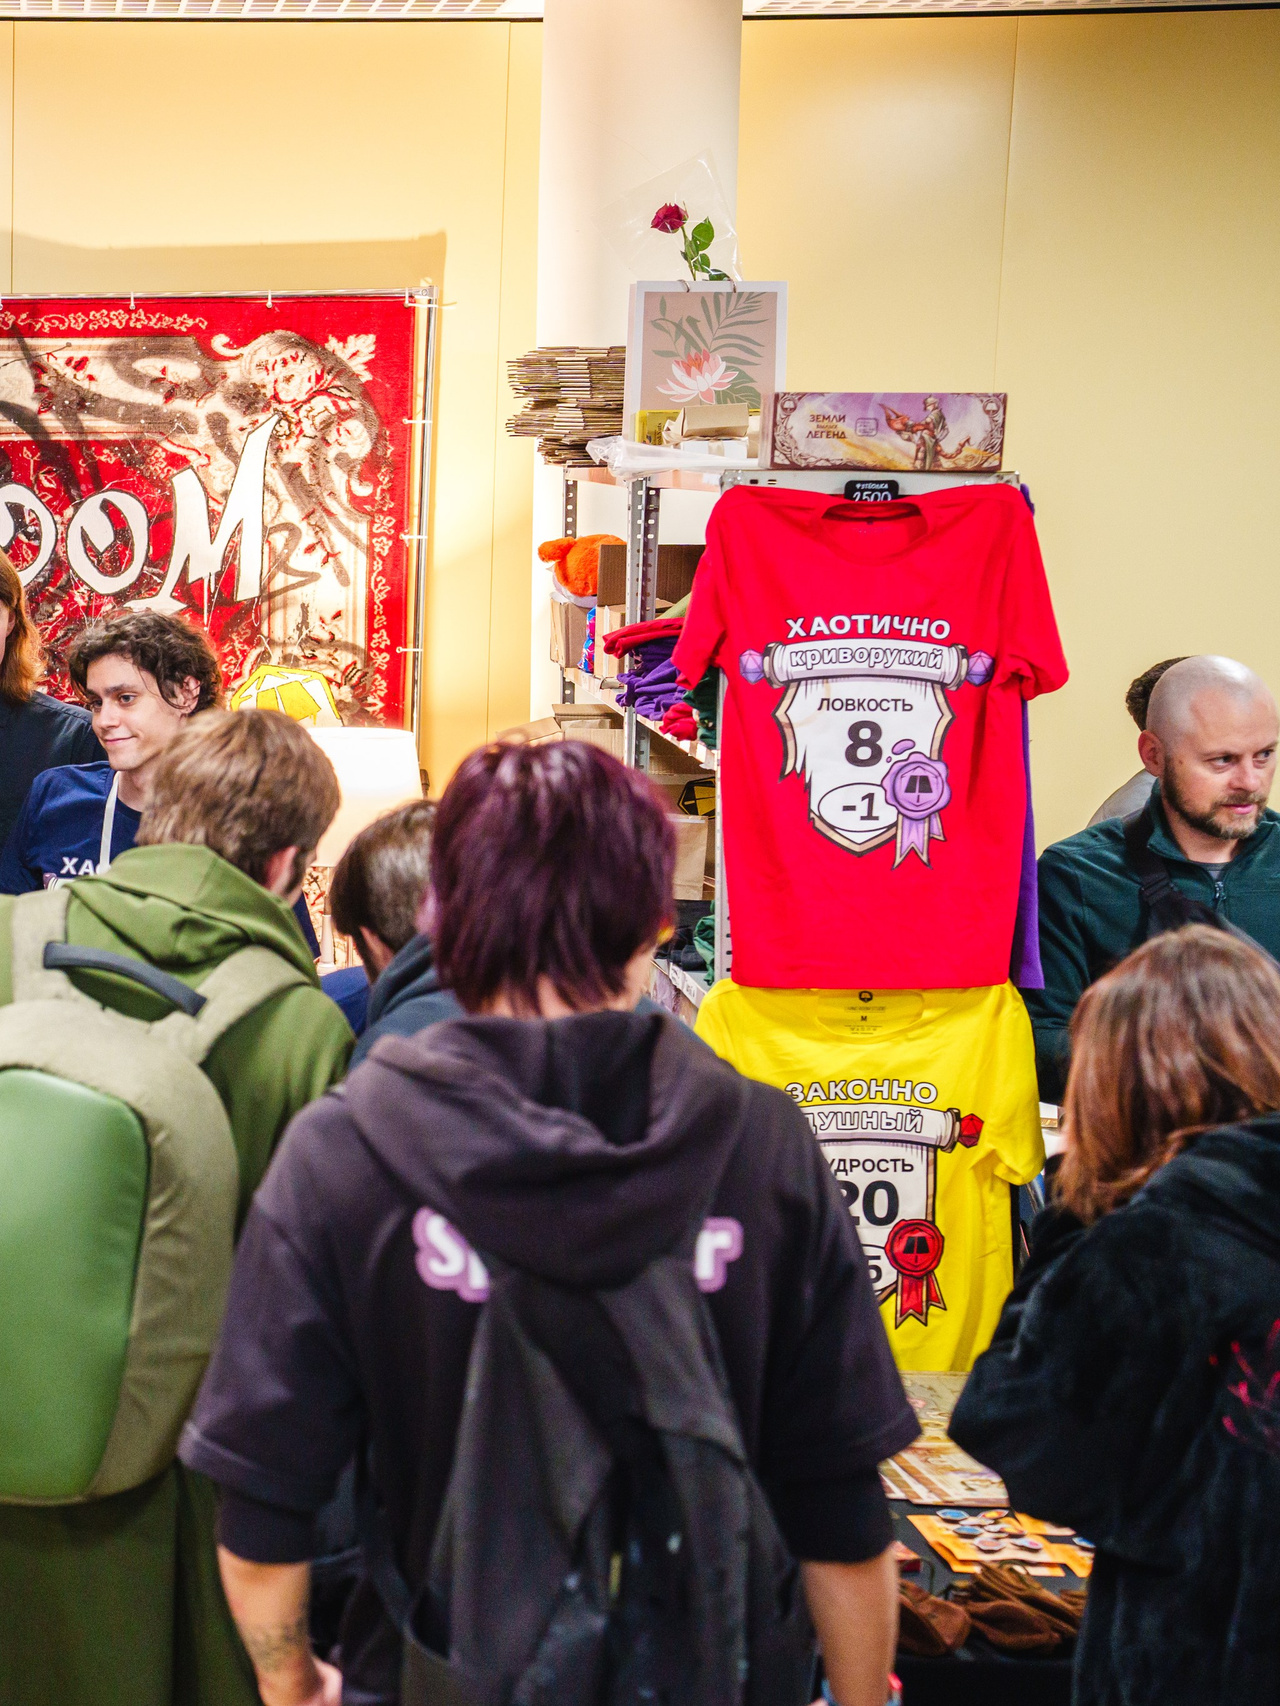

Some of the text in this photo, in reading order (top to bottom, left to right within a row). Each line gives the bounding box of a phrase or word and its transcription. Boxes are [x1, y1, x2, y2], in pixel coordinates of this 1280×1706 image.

[809, 414, 846, 423] ЗЕМЛИ
[806, 430, 848, 439] ЛЕГЕНД
[786, 614, 951, 640] ХАОТИЧНО
[790, 646, 943, 670] криворукий
[817, 698, 913, 712] ЛОВКОСТЬ
[845, 720, 883, 767] 8
[842, 792, 880, 821] -1
[785, 1079, 938, 1104] ЗАКОННО
[830, 1158, 914, 1176] ДРОСТЬ
